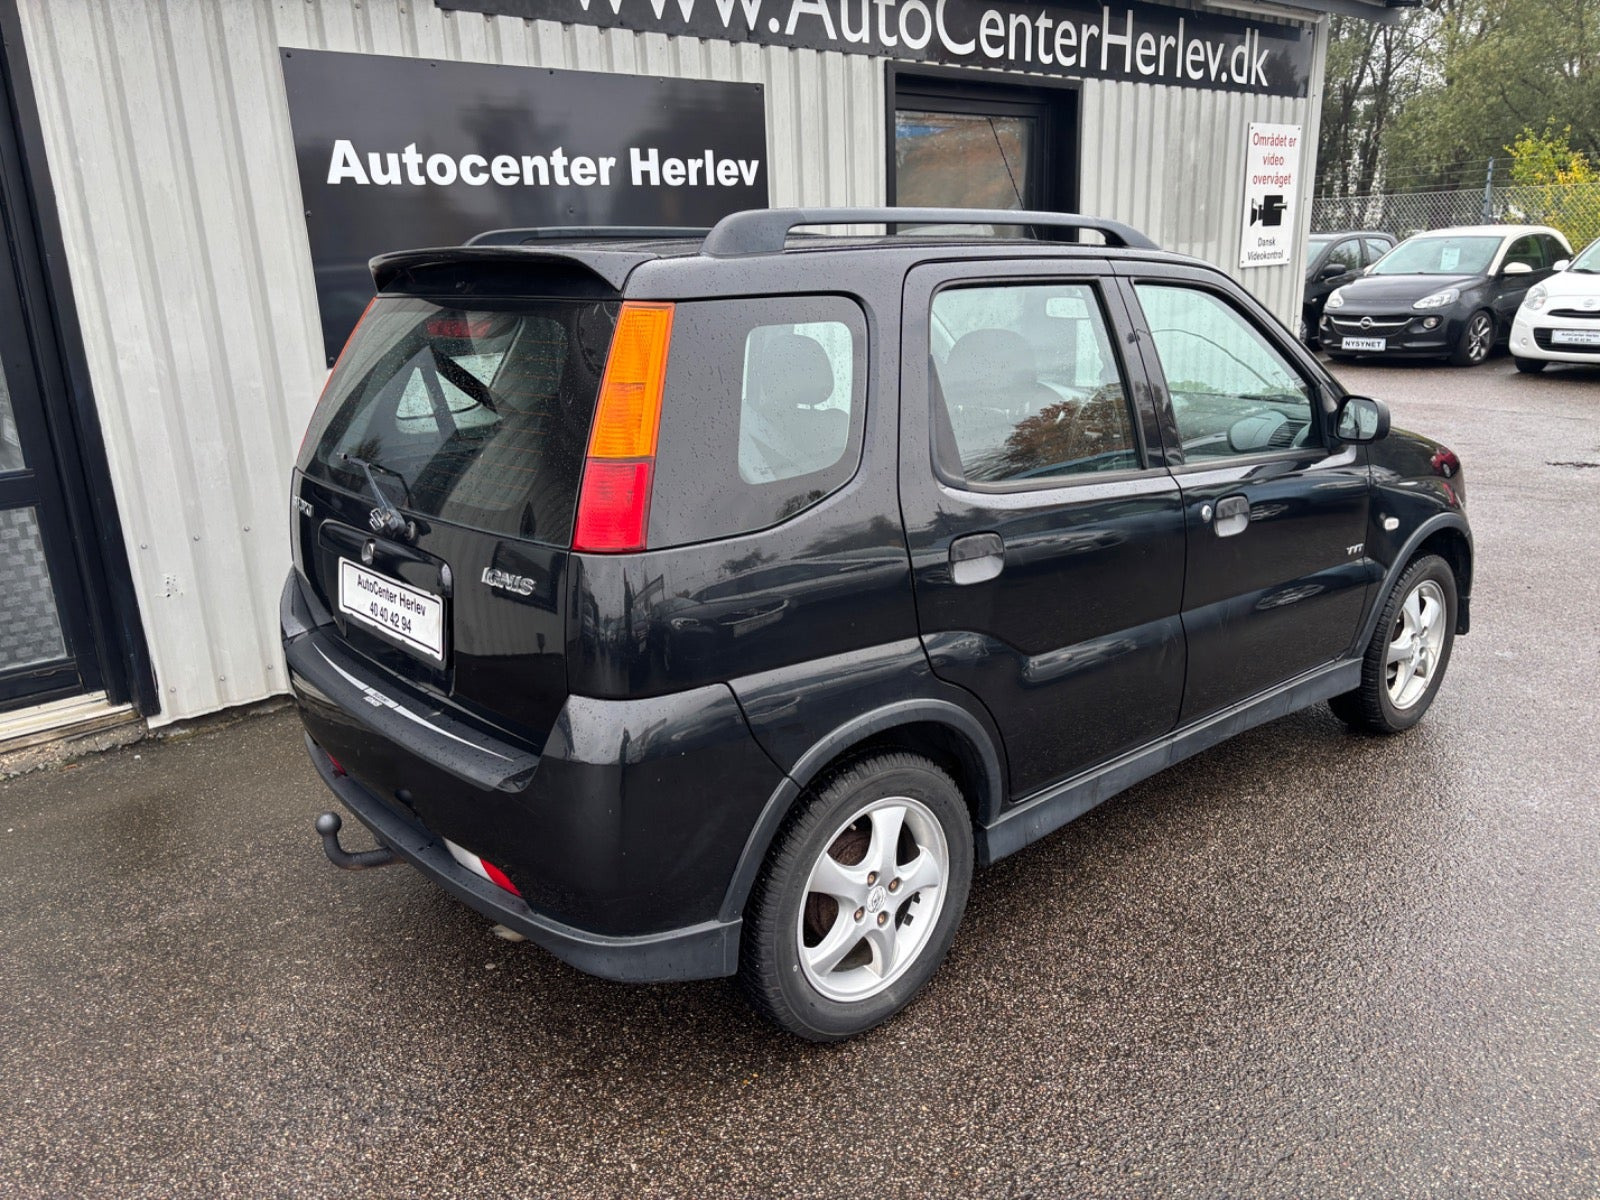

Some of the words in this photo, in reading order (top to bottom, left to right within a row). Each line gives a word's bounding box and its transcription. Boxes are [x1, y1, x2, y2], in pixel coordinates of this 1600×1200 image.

[578, 0, 1269, 87] w.AutoCenterHerlev.dk
[1252, 131, 1287, 147] Området
[1288, 137, 1297, 148] er
[326, 139, 616, 186] Autocenter
[629, 147, 760, 187] Herlev
[1262, 153, 1285, 166] video
[1252, 172, 1292, 188] overvåget
[1257, 237, 1276, 248] Dansk
[1247, 249, 1284, 261] Videokontrol
[1345, 340, 1381, 348] NYSYNET
[357, 574, 397, 604] AutoCenter
[399, 592, 426, 616] Herlev
[369, 601, 378, 617] 40
[379, 606, 388, 622] 40
[390, 611, 399, 628] 42
[401, 616, 411, 633] 94
